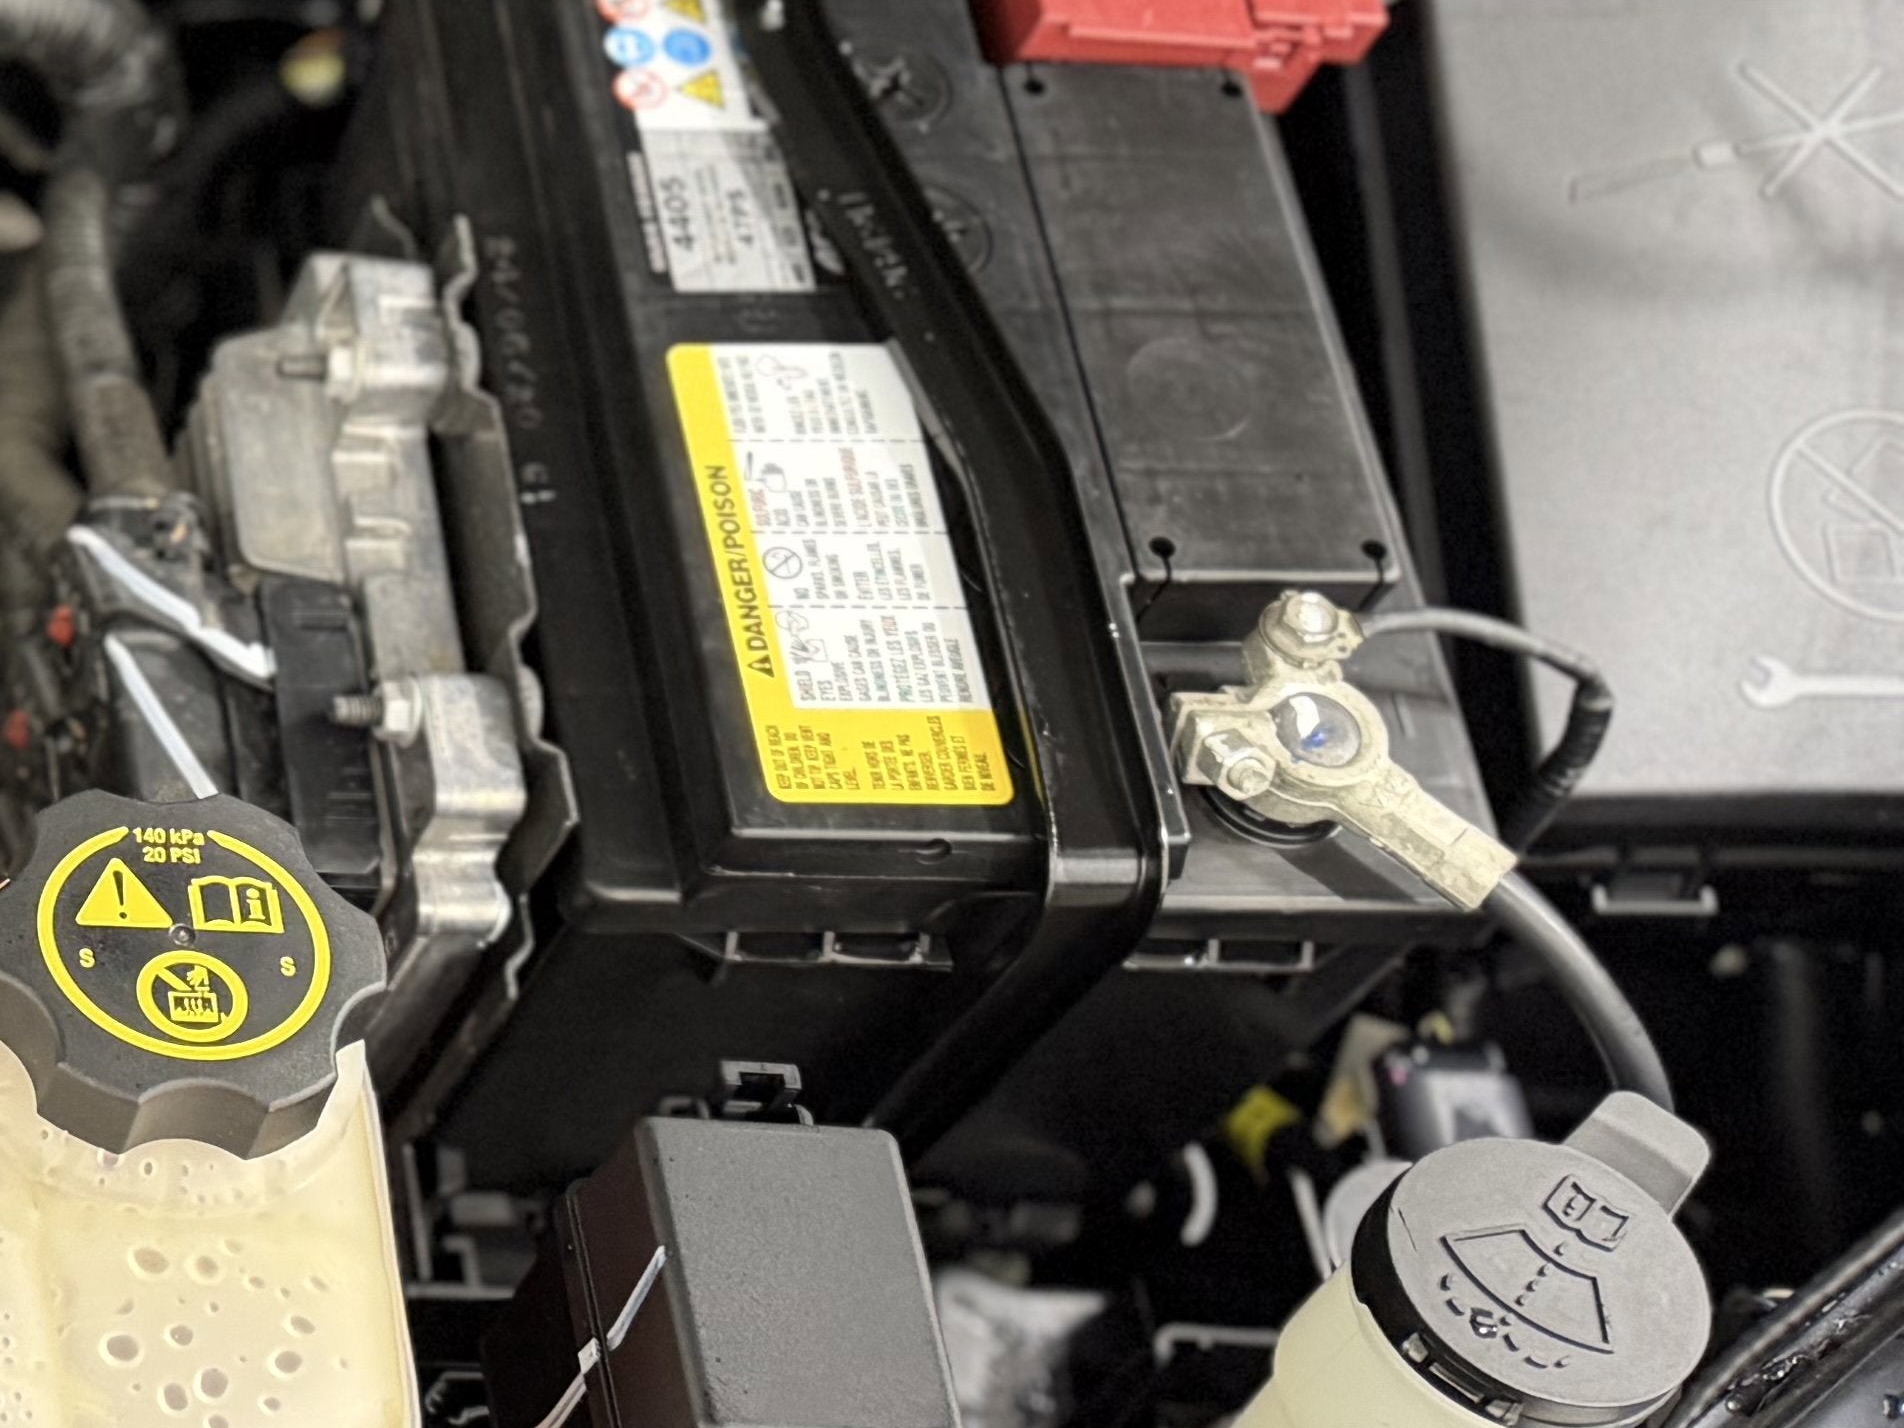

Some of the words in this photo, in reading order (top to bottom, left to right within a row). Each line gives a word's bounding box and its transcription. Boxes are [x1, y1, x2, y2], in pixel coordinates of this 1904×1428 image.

[705, 464, 769, 660] DANGER/POISON
[132, 827, 166, 845] 140
[169, 827, 206, 847] kPa
[142, 847, 166, 864] 20
[169, 847, 201, 865] PSI
